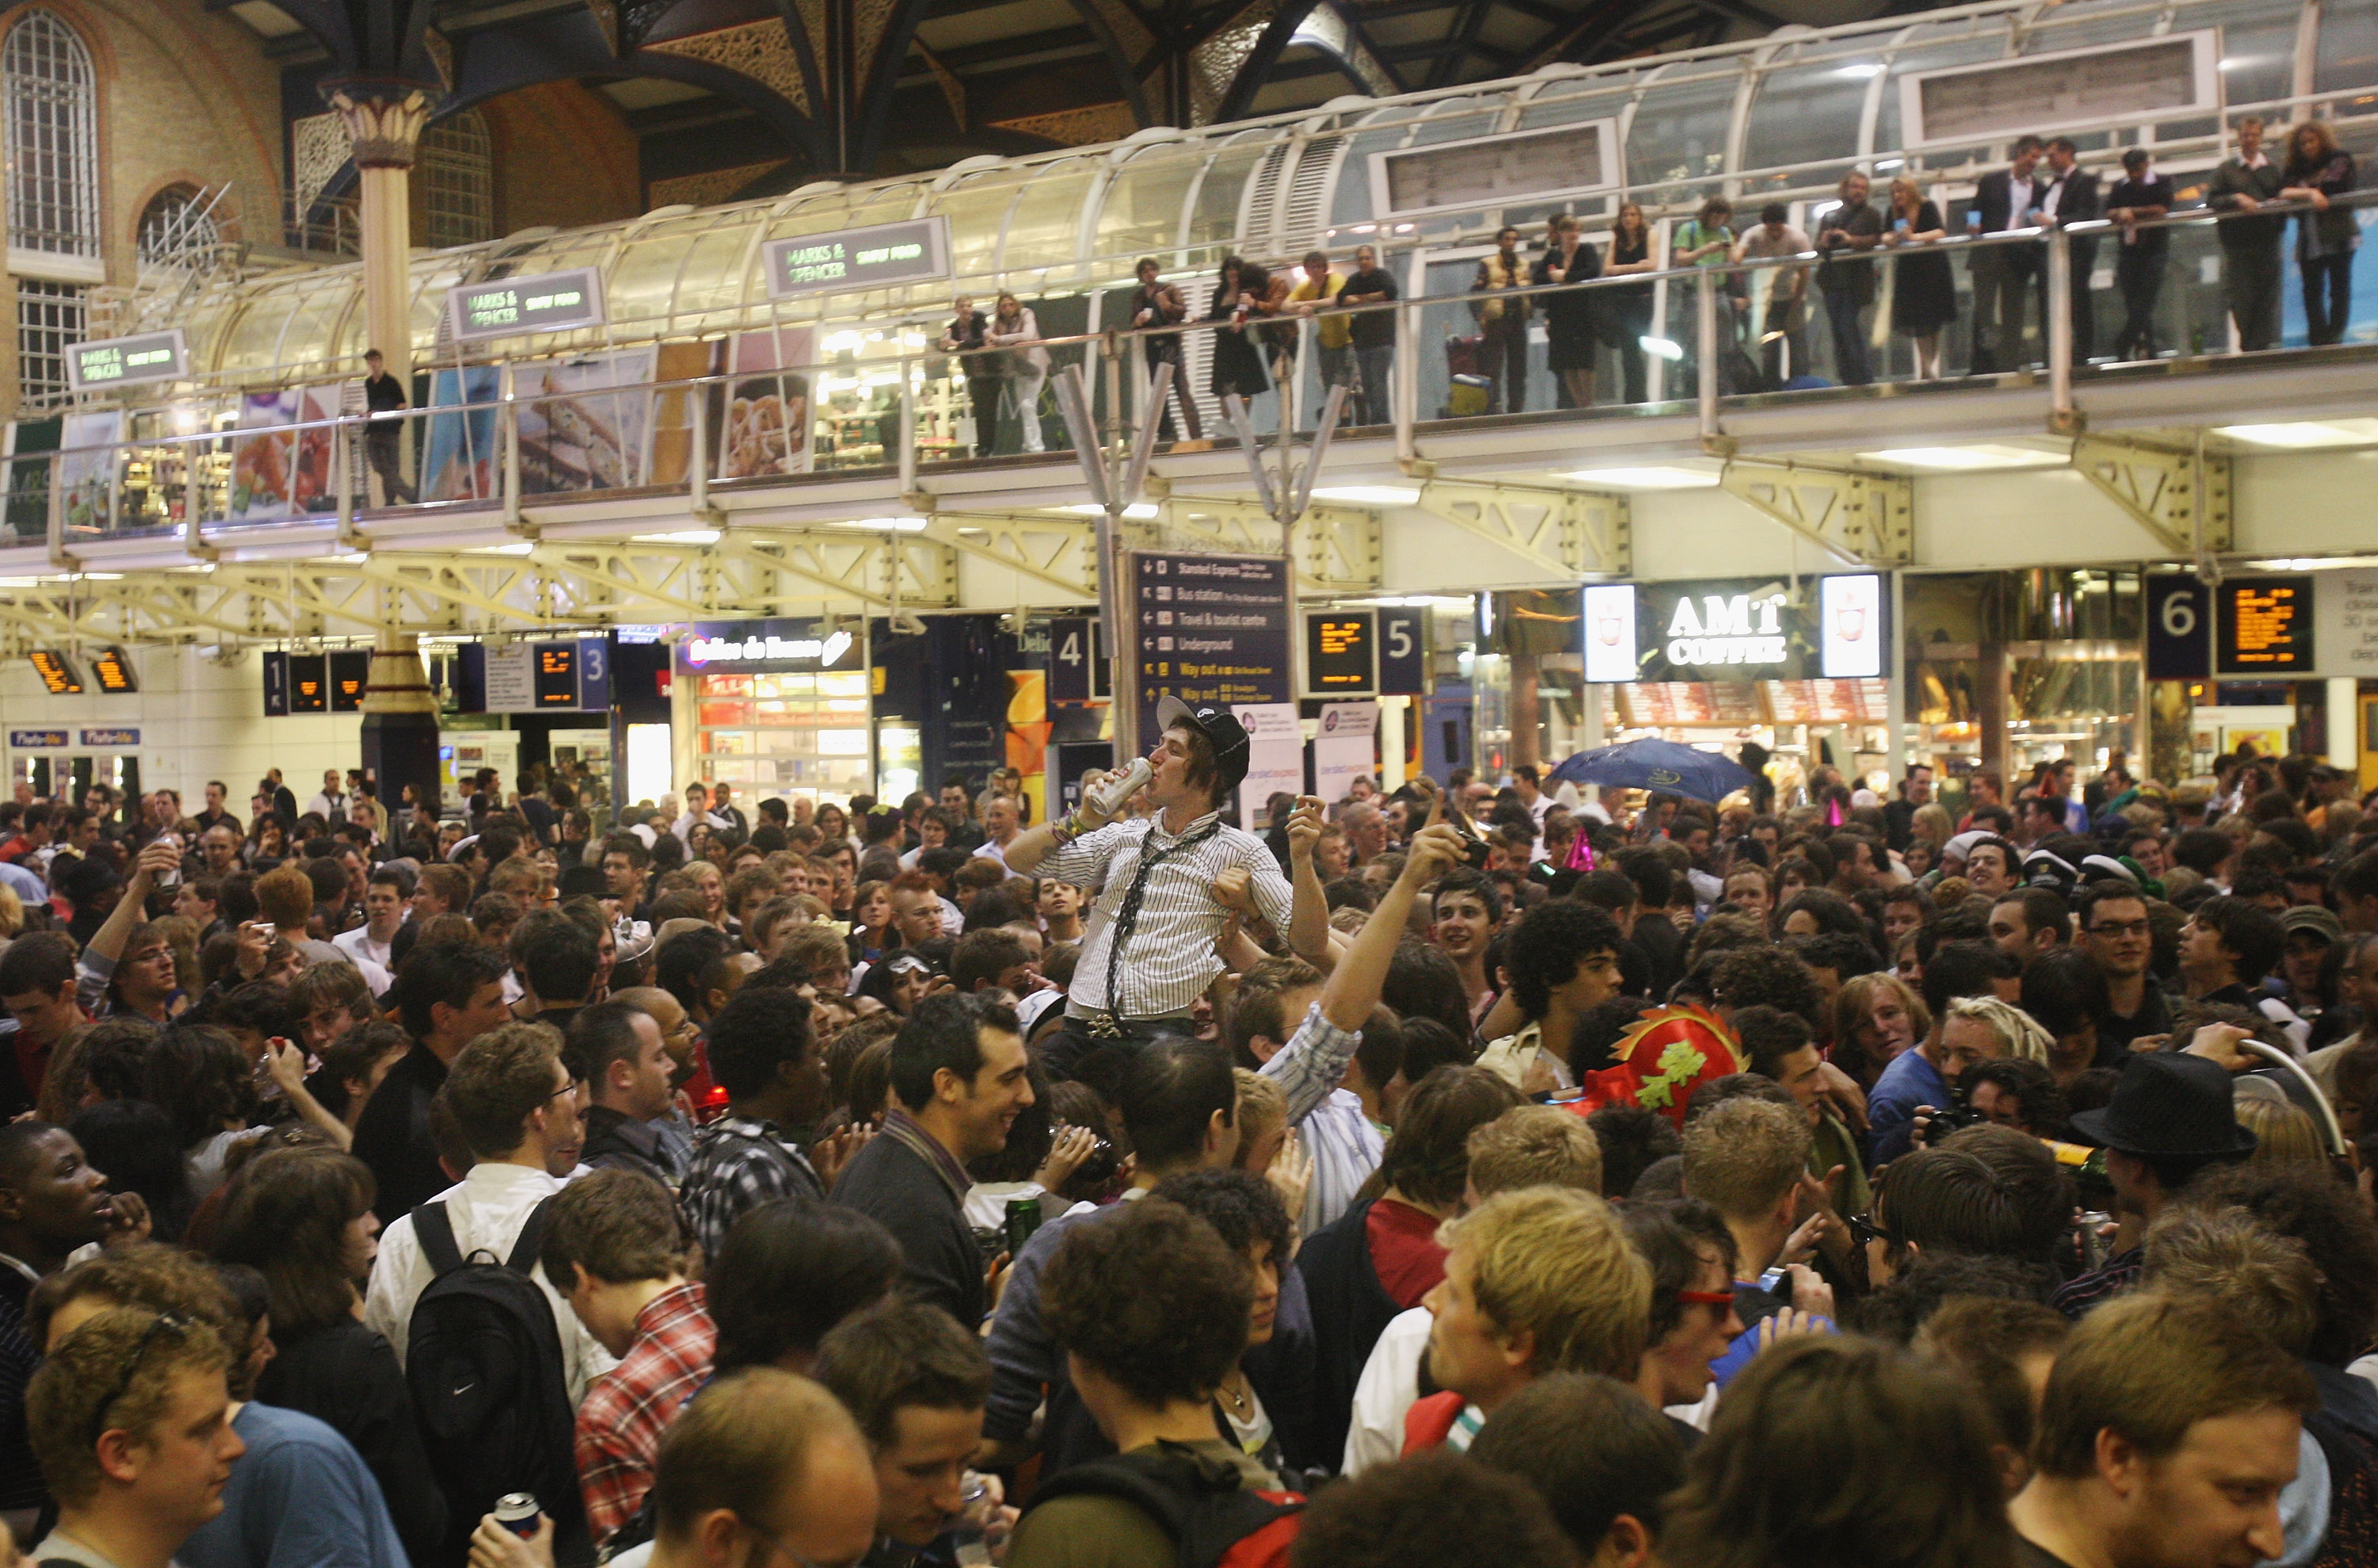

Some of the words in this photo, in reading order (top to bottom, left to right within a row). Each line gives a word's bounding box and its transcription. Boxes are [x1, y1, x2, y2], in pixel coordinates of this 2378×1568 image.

[786, 246, 832, 266] MARKS
[834, 243, 846, 259] &
[1178, 587, 1194, 600] Bus
[1195, 589, 1223, 600] station
[1179, 612, 1203, 625] Travel
[2162, 591, 2196, 637] 6
[1059, 632, 1082, 666] 4
[1179, 637, 1233, 653] Underground
[1389, 620, 1413, 658] 5
[1667, 636, 1787, 665] COFFEE
[271, 660, 281, 689] 1
[587, 648, 603, 681] 3
[1179, 663, 1199, 679] Way
